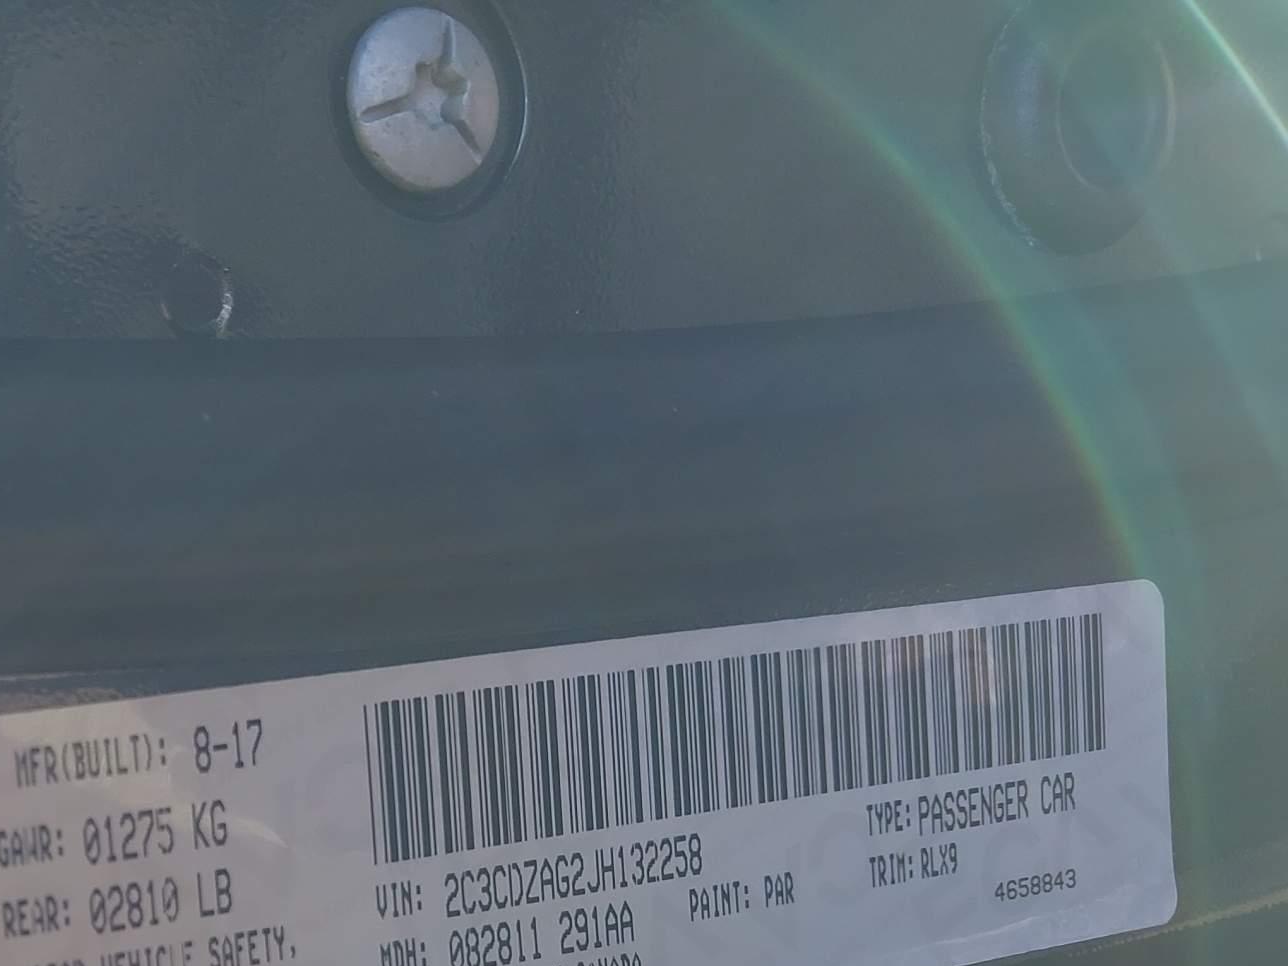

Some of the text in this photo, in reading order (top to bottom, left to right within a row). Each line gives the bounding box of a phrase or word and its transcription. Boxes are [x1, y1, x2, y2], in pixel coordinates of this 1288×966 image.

[14, 735, 169, 789] MFR(BUILT):
[193, 718, 263, 774] 8-17
[82, 807, 175, 866] 01275
[191, 799, 229, 850] KG
[866, 772, 1077, 836] TYPE: PASSENGER CAR
[375, 832, 704, 919] VIN: 2C3CDZAG2JH132258
[688, 871, 796, 922] PAINT: PAR
[868, 842, 959, 889] TRIM: RLX9
[994, 867, 1078, 902] 4658843
[1, 867, 234, 939] REAR: 02810 LB
[560, 900, 635, 955] 291AA
